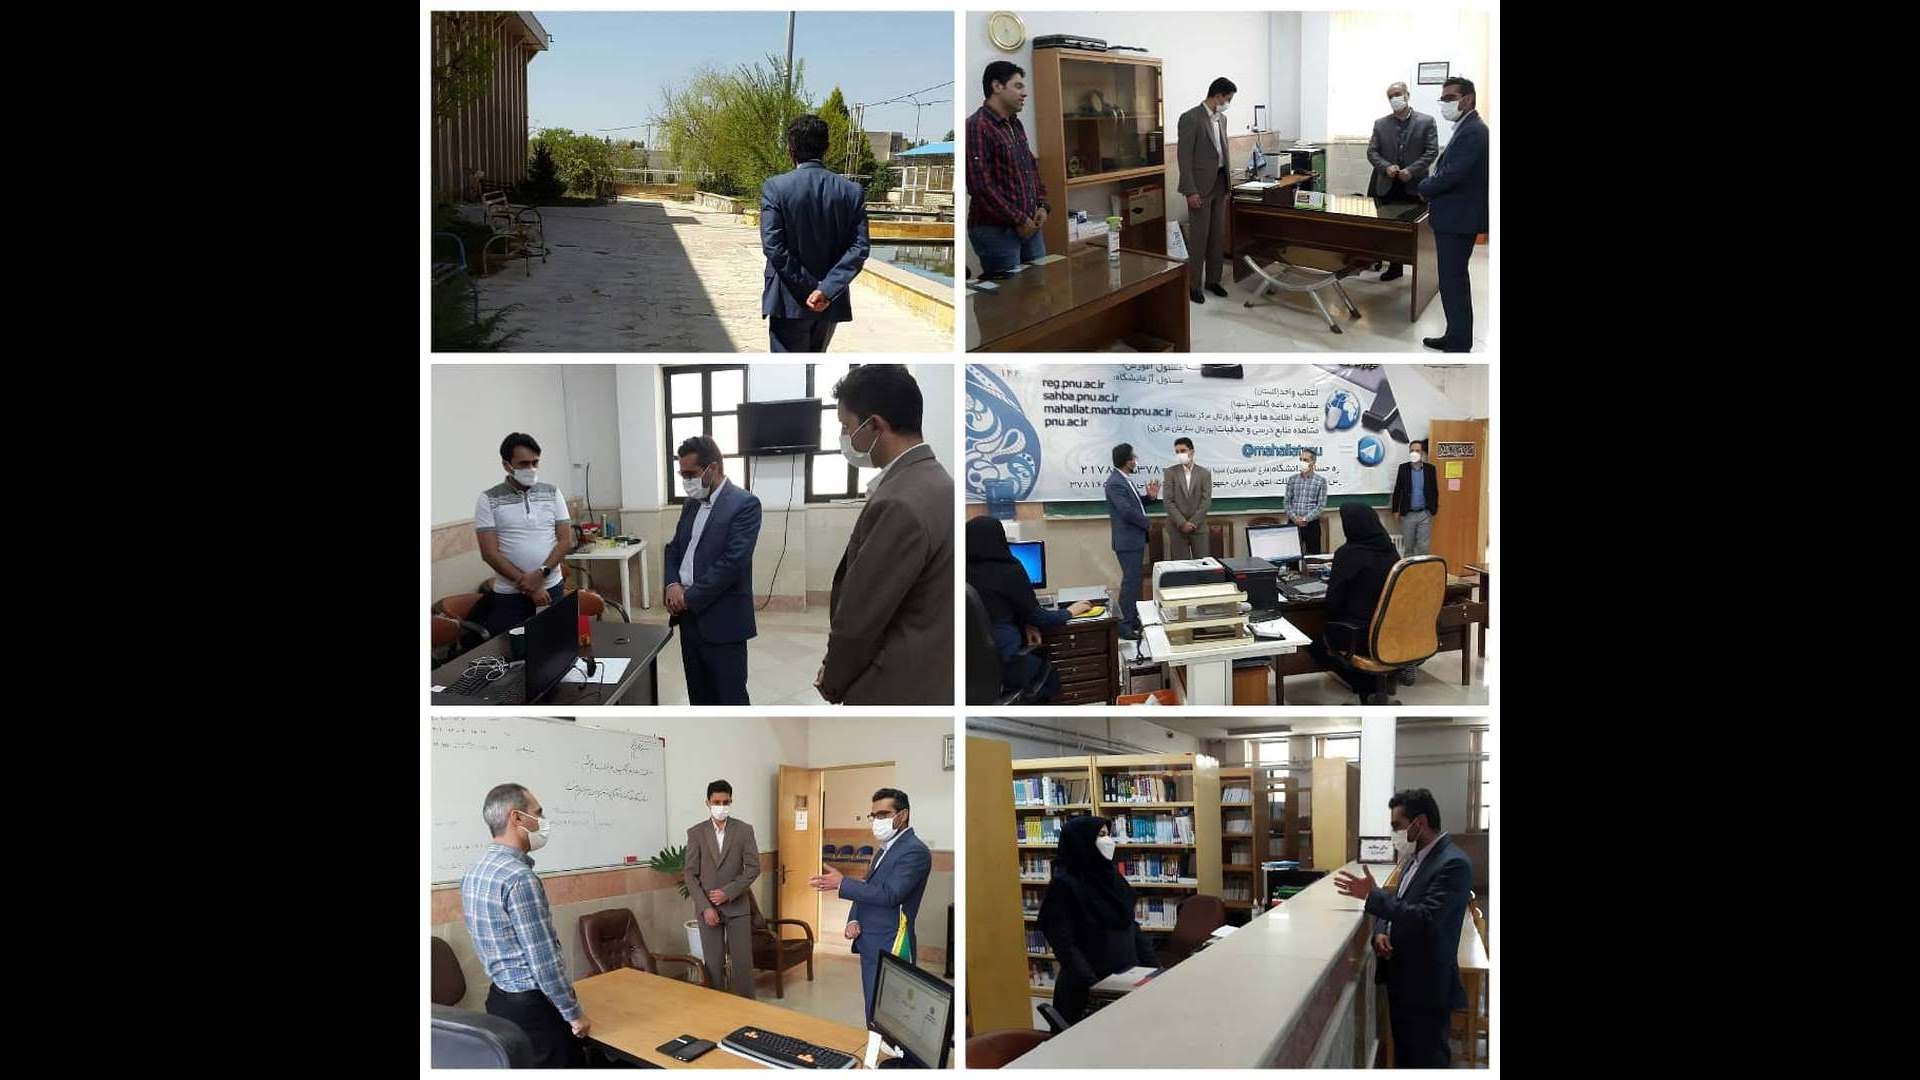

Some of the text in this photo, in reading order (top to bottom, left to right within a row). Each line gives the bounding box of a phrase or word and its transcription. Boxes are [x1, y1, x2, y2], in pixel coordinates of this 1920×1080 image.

[1042, 379, 1105, 389] reg.pnu.ac.ir
[1042, 390, 1120, 403] sahba.pnu.ac.ir
[1044, 403, 1173, 417] mahallat.markazi.pnu.ac.ir
[1044, 417, 1089, 428] pnu.ac.ir
